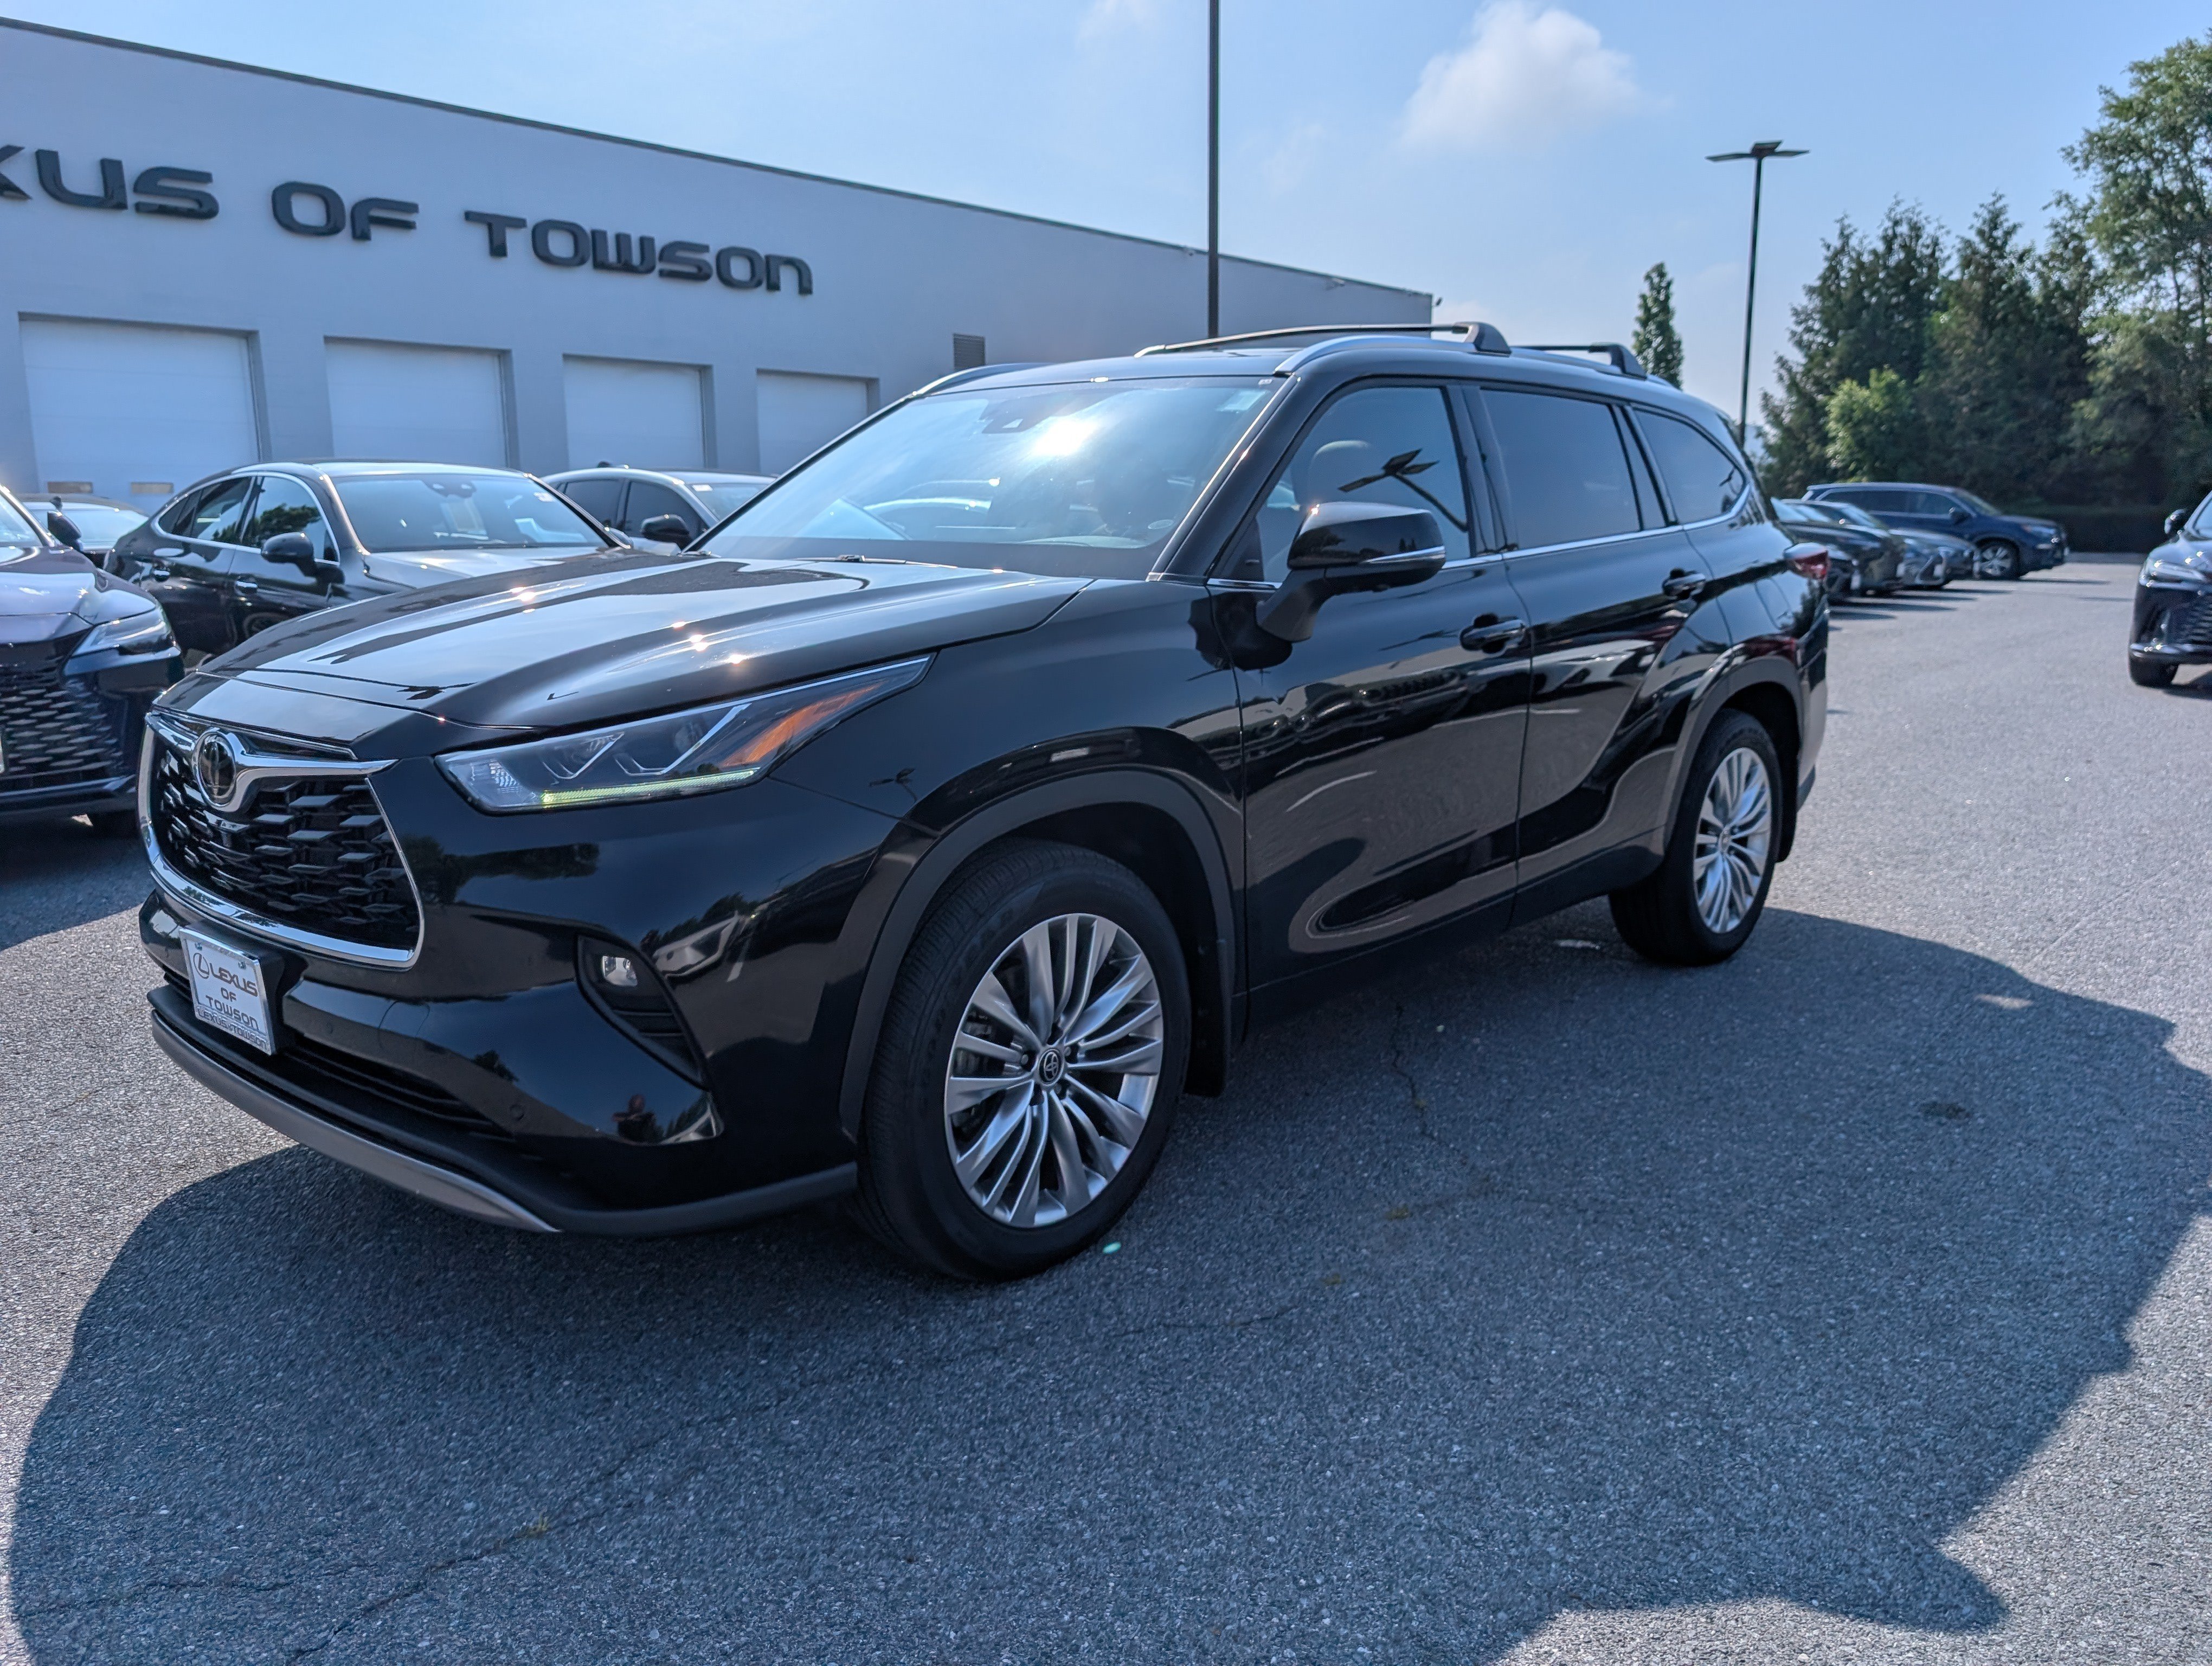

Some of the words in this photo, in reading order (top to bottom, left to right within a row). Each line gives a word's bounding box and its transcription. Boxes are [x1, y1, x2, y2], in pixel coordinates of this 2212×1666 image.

[271, 181, 420, 241] OF
[464, 210, 813, 295] TOWSON
[209, 962, 258, 997] LEXUS
[221, 988, 236, 1002] OF
[198, 1009, 227, 1028] LEXUS
[230, 1023, 268, 1052] TOWSON
[205, 995, 259, 1031] TOWSON
